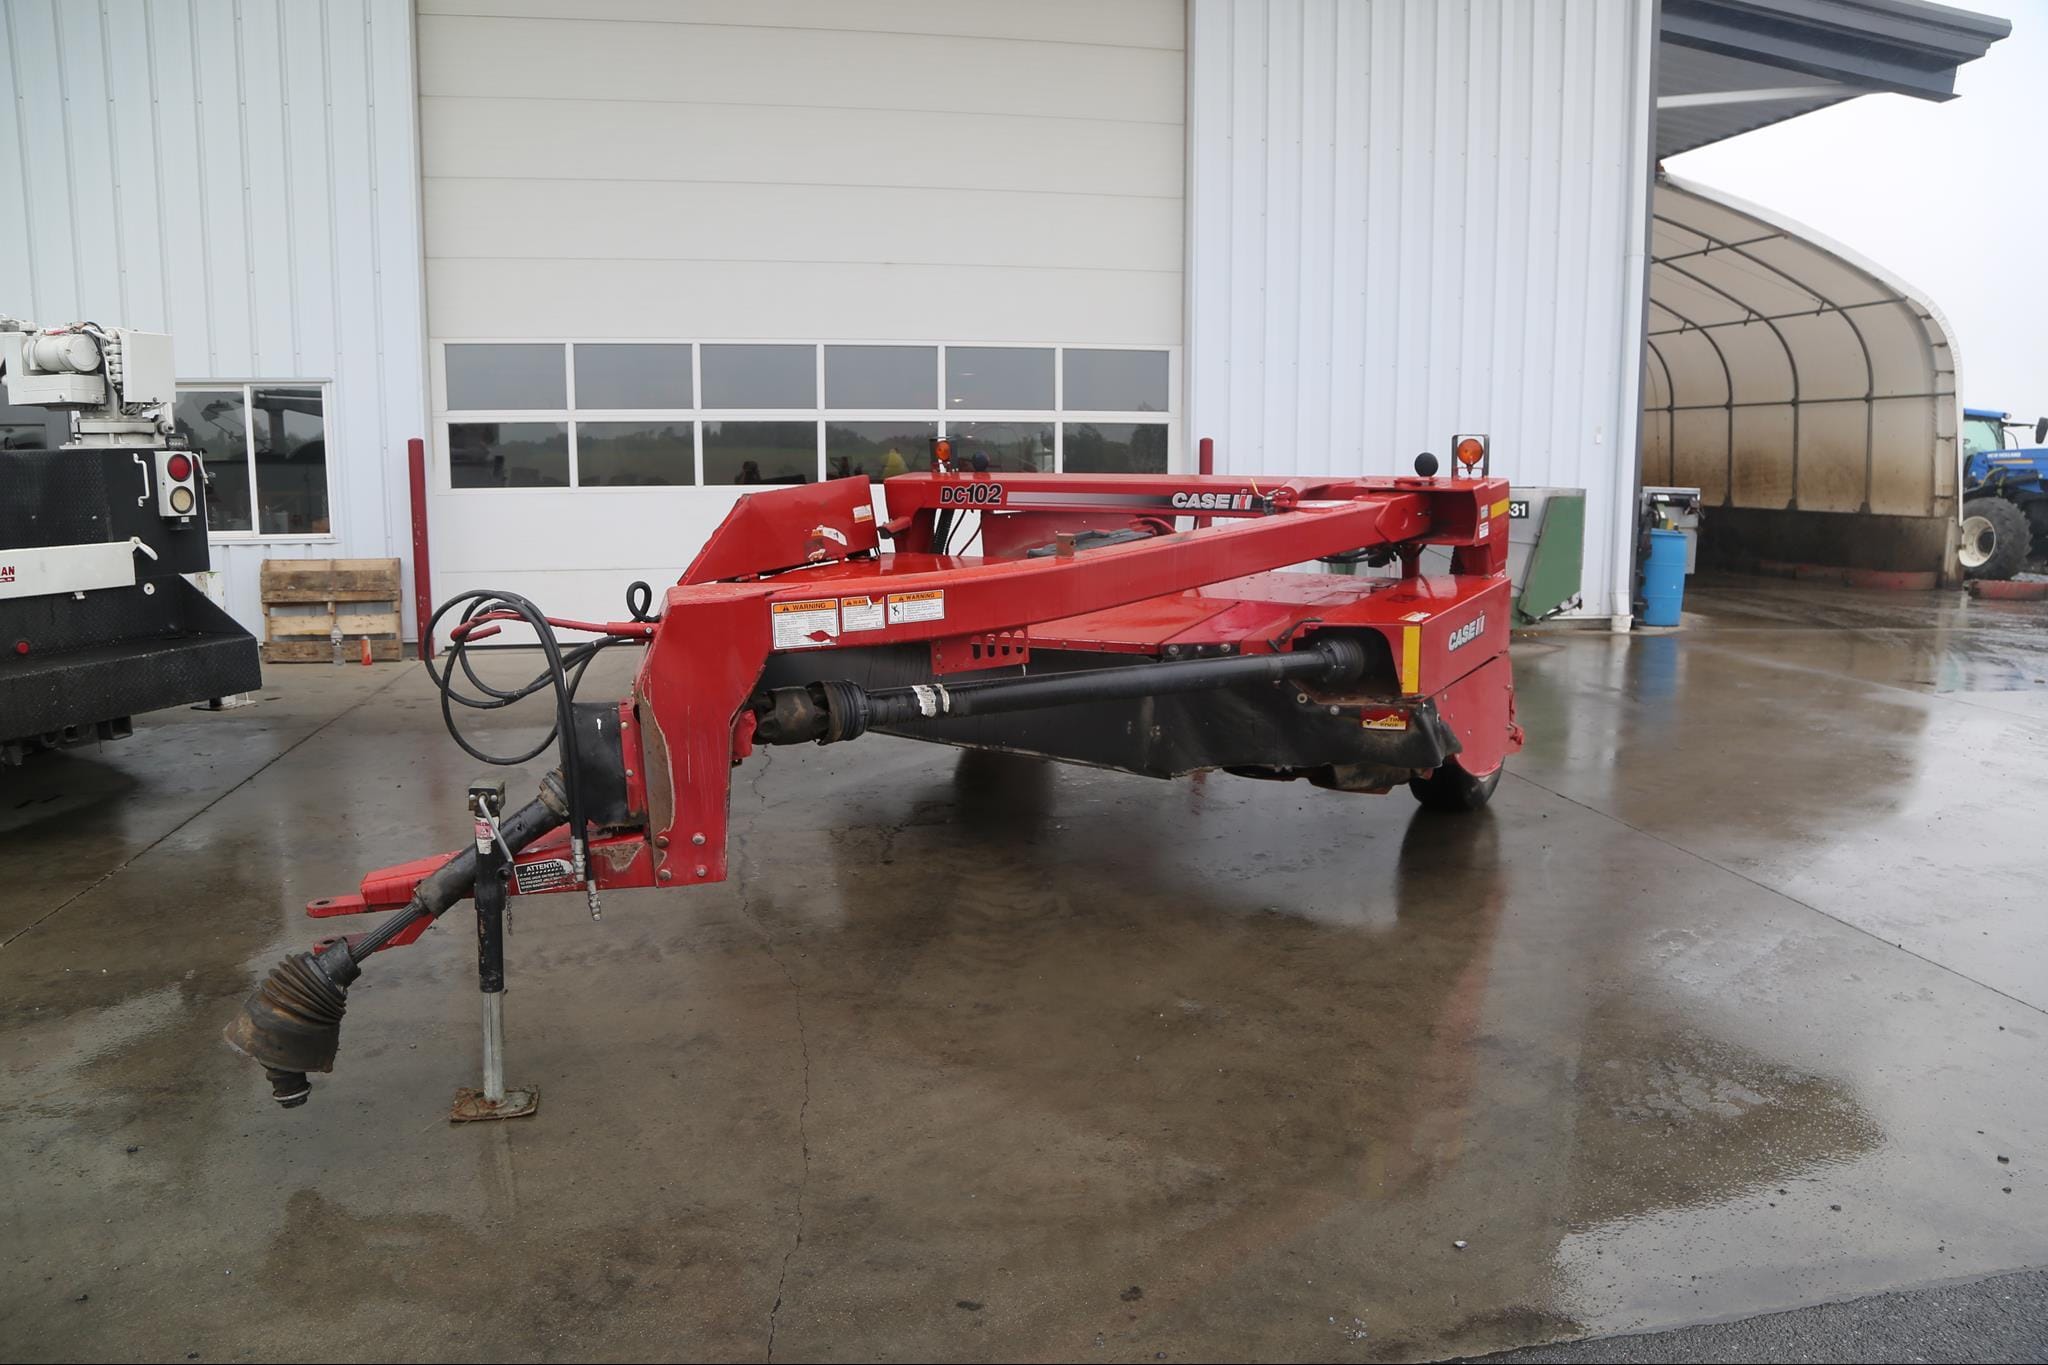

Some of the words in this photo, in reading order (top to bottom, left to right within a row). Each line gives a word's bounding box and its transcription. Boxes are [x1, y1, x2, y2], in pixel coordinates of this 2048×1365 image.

[941, 484, 1003, 506] DC102
[1172, 492, 1231, 509] CASE
[1509, 503, 1526, 517] 31
[905, 592, 936, 601] WARNING
[792, 602, 827, 611] WARNING
[526, 861, 561, 873] ATTENTIO
